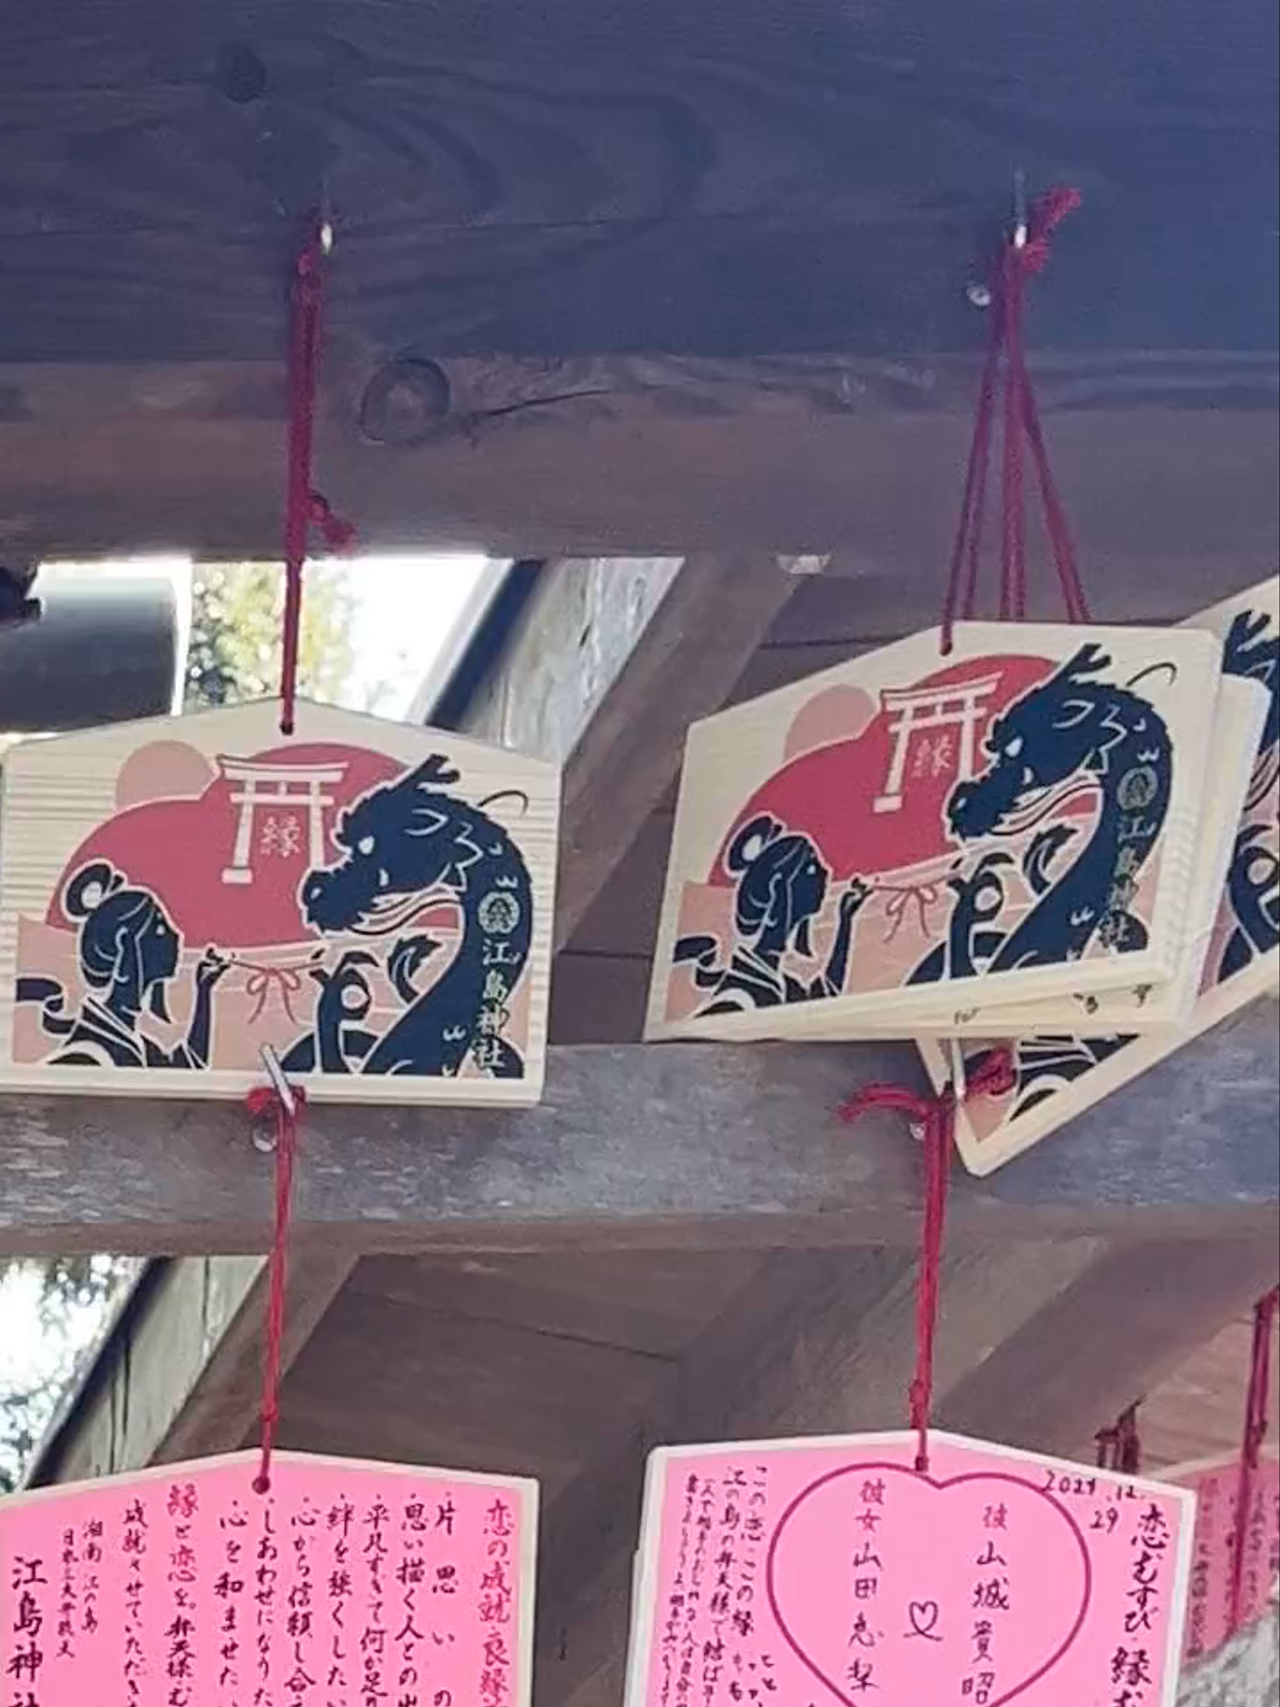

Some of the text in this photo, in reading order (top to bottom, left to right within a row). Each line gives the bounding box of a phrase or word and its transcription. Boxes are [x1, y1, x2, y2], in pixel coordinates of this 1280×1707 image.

[260, 813, 302, 860] 縁
[471, 936, 522, 1068] 江島神社
